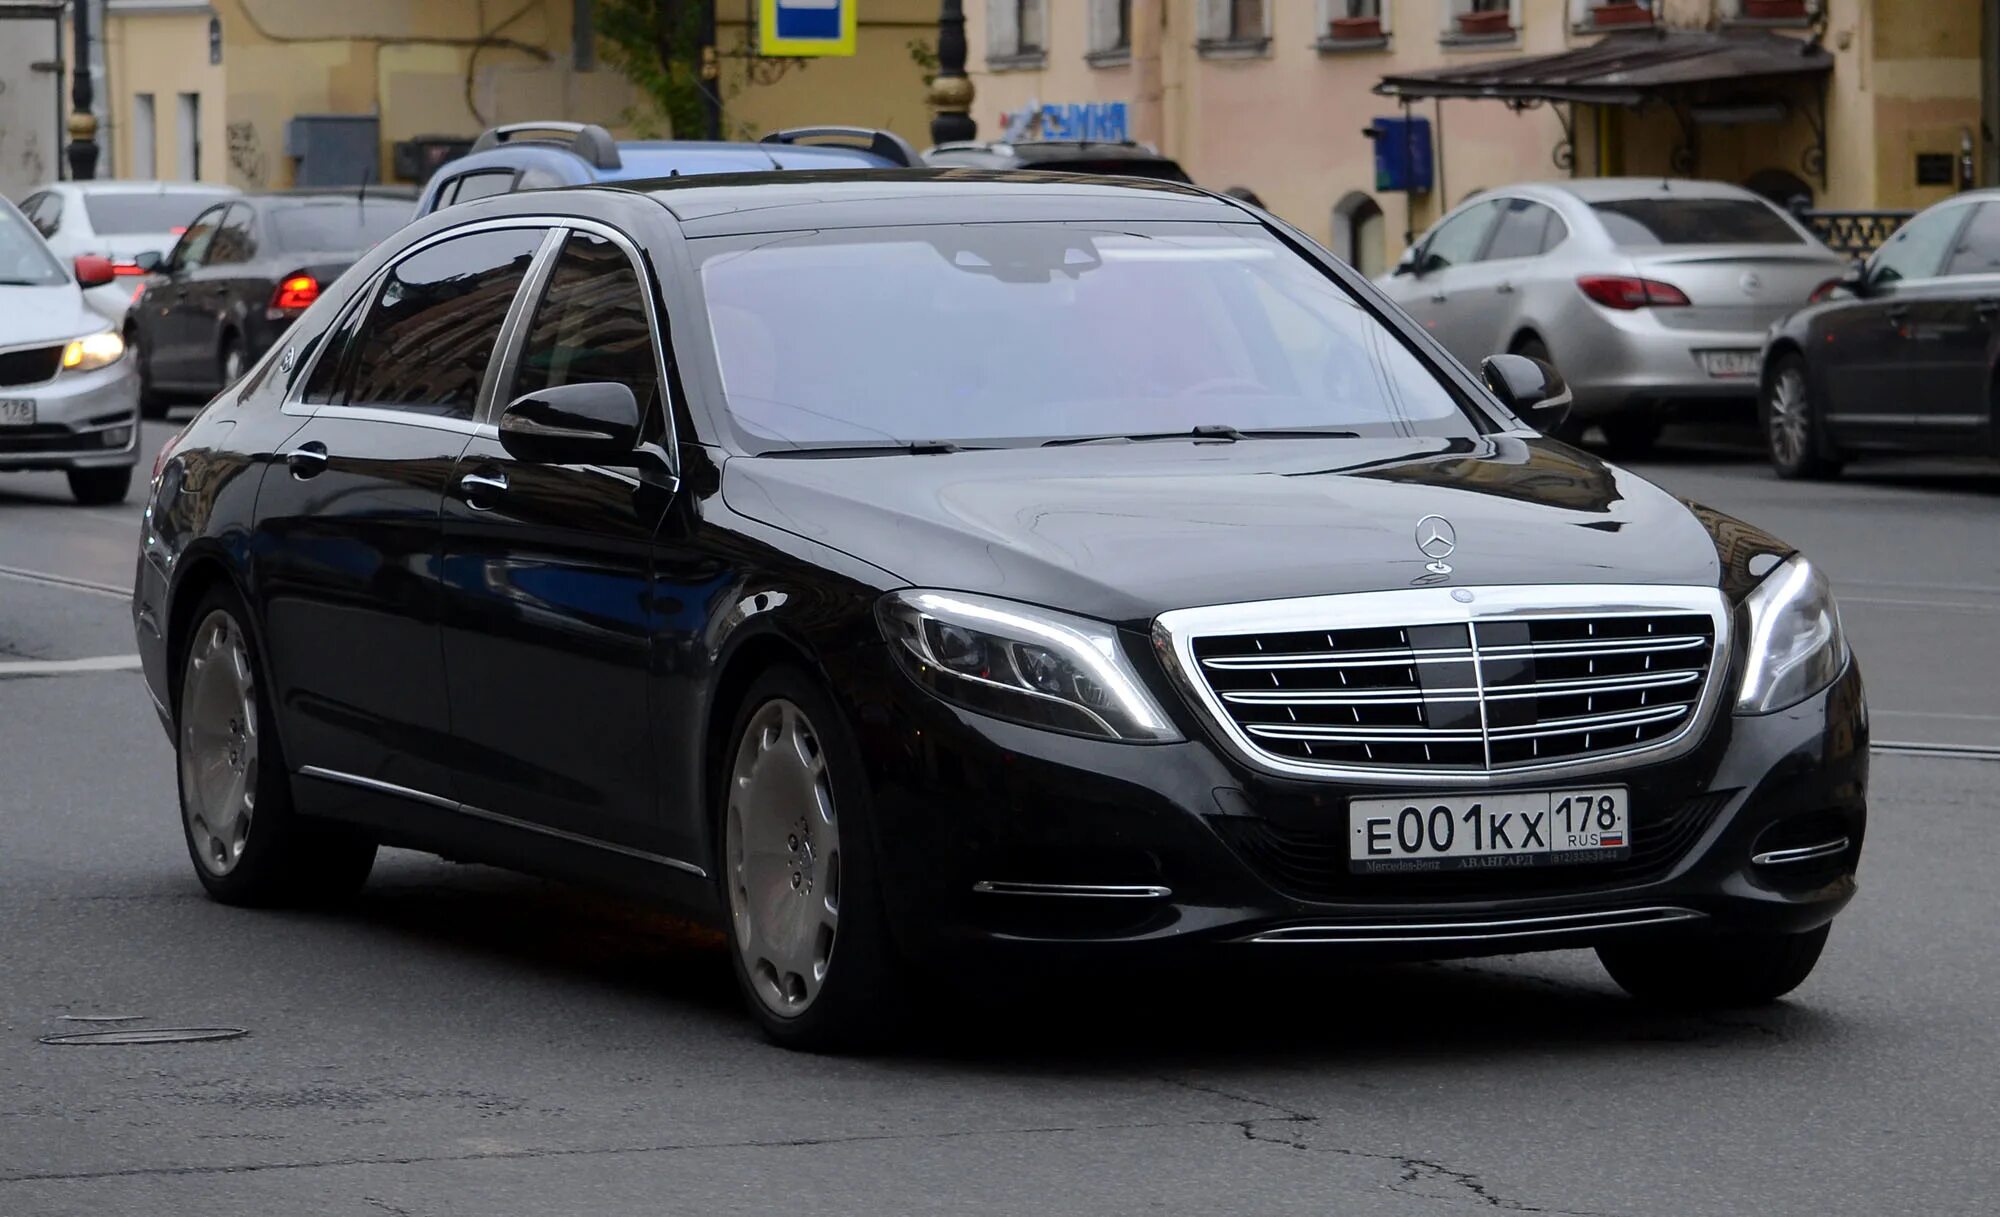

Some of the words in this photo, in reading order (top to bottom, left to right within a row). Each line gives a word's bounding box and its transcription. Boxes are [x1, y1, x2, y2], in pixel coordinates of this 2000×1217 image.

[1556, 795, 1616, 833] 178
[1568, 833, 1599, 847] RUS
[1366, 860, 1440, 872] Mercedes-Benz
[1458, 856, 1534, 869] АВАНГАРД
